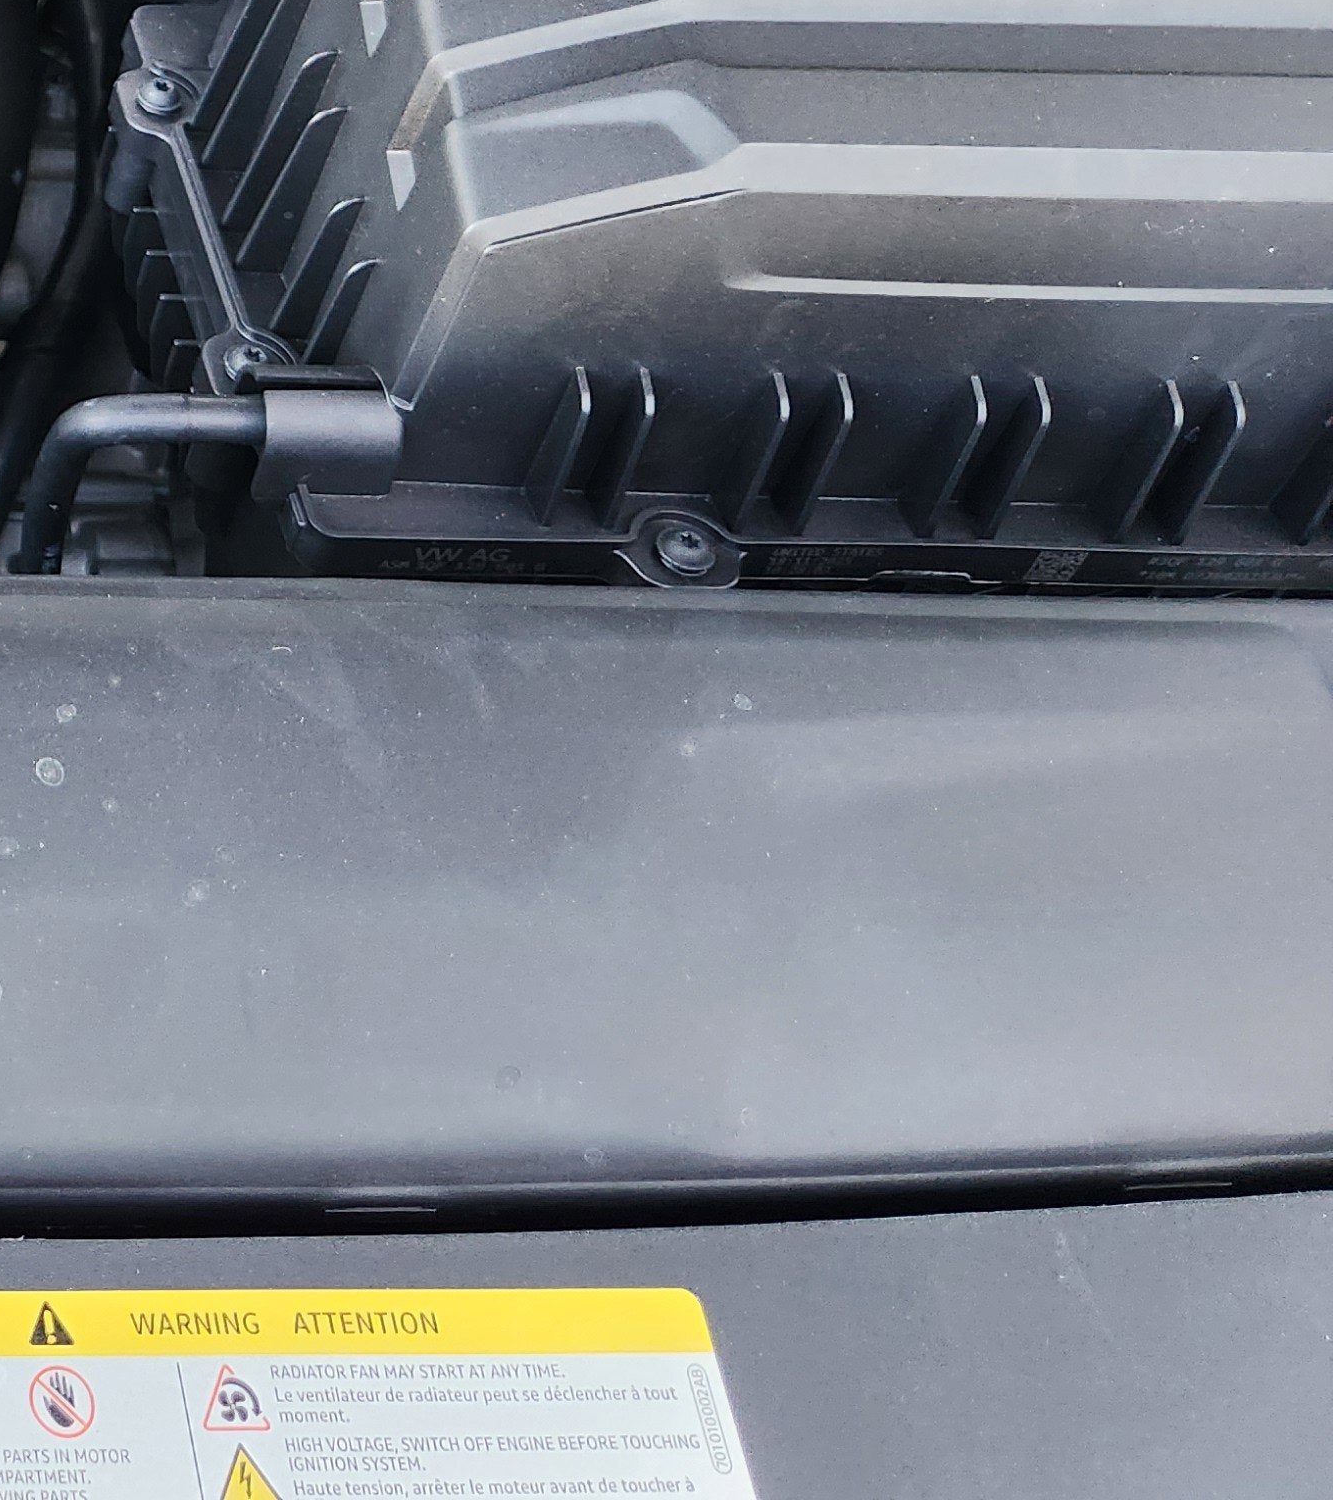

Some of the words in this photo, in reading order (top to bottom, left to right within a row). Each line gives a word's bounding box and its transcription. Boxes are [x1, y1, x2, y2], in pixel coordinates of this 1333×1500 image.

[129, 1312, 261, 1336] WARNING
[294, 1311, 439, 1335] ATTENTION
[269, 1363, 347, 1380] RADIATOR
[349, 1363, 381, 1380] FAN
[384, 1364, 417, 1380] MAY
[418, 1363, 466, 1380] START
[468, 1363, 486, 1380] AT
[490, 1363, 520, 1380] ANY
[522, 1363, 567, 1379] TIME.
[274, 1386, 294, 1404] Le
[296, 1385, 381, 1404] ventilateur
[385, 1386, 404, 1403] de
[408, 1386, 480, 1404] radiateur
[482, 1386, 518, 1406] peut
[522, 1388, 541, 1403] se
[544, 1384, 627, 1403] déclencher
[630, 1384, 641, 1402] à
[644, 1385, 679, 1402] tout
[278, 1408, 351, 1424] moment.
[284, 1436, 324, 1453] HIGH
[325, 1436, 399, 1455] VOLTAGE,
[401, 1436, 461, 1453] SWITCH
[464, 1436, 494, 1453] OFF
[497, 1435, 556, 1452] ENGINE
[558, 1434, 620, 1451] BEFORE
[620, 1433, 701, 1451] TOUCHING
[3, 1448, 51, 1465] PARTS
[53, 1448, 72, 1465] IN
[74, 1448, 132, 1464] MOTOR
[288, 1456, 359, 1473] IGNITION
[361, 1456, 427, 1473] SYSTEM.
[293, 1479, 342, 1497] Haute
[344, 1479, 410, 1499] tension,
[412, 1478, 466, 1497] arrêter
[468, 1478, 484, 1496] le
[487, 1479, 546, 1496] moteur
[549, 1479, 595, 1495] avant
[598, 1476, 617, 1494] de
[620, 1476, 681, 1494] toucher
[685, 1475, 696, 1493] à
